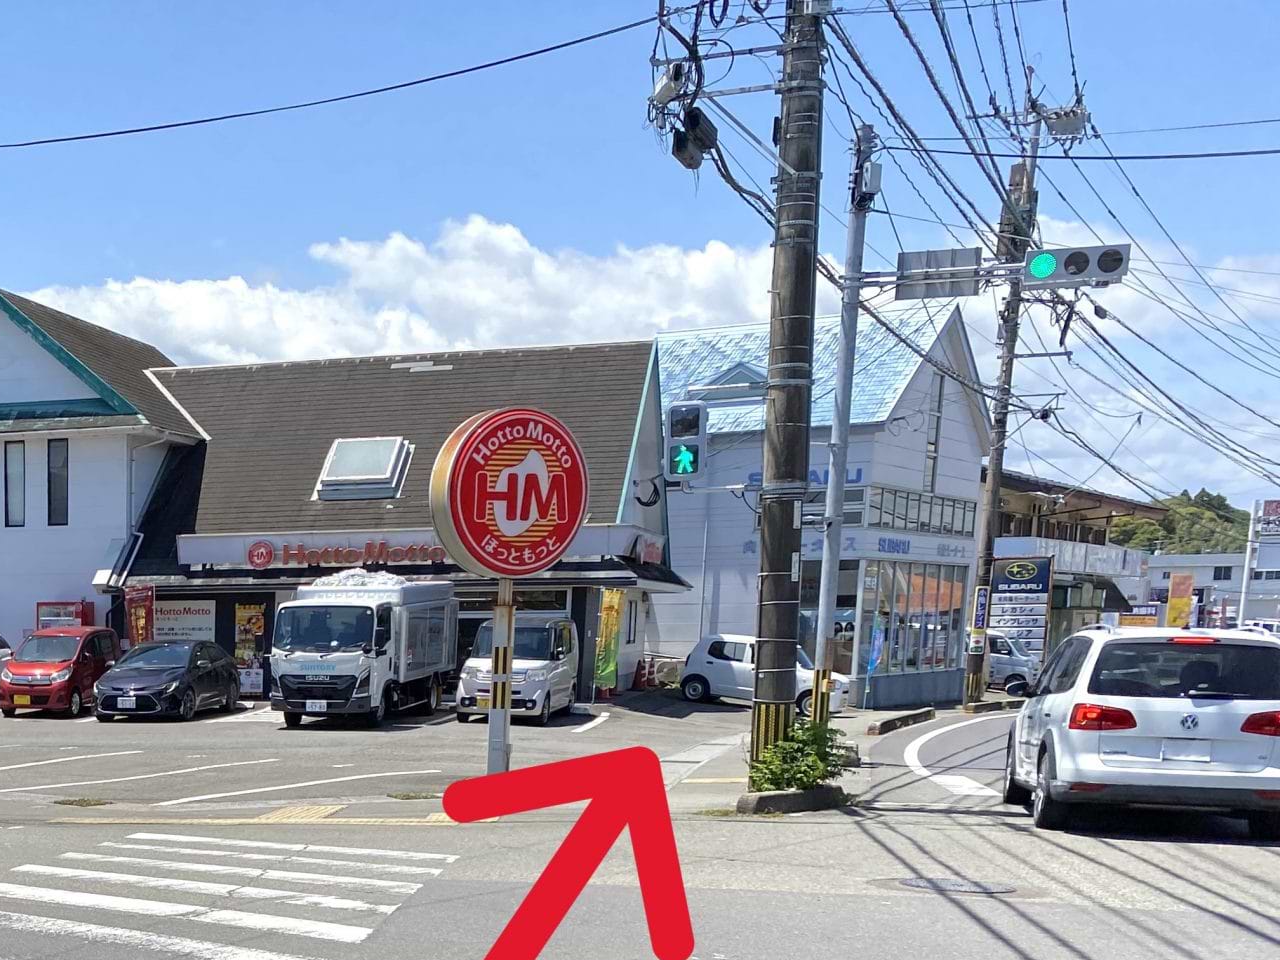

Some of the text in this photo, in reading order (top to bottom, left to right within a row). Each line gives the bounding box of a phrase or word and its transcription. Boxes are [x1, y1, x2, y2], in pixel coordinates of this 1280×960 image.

[474, 471, 568, 523] HM
[481, 534, 560, 564] ほっともっと
[998, 583, 1042, 591] SUBARU
[300, 663, 337, 671] SUNTORY
